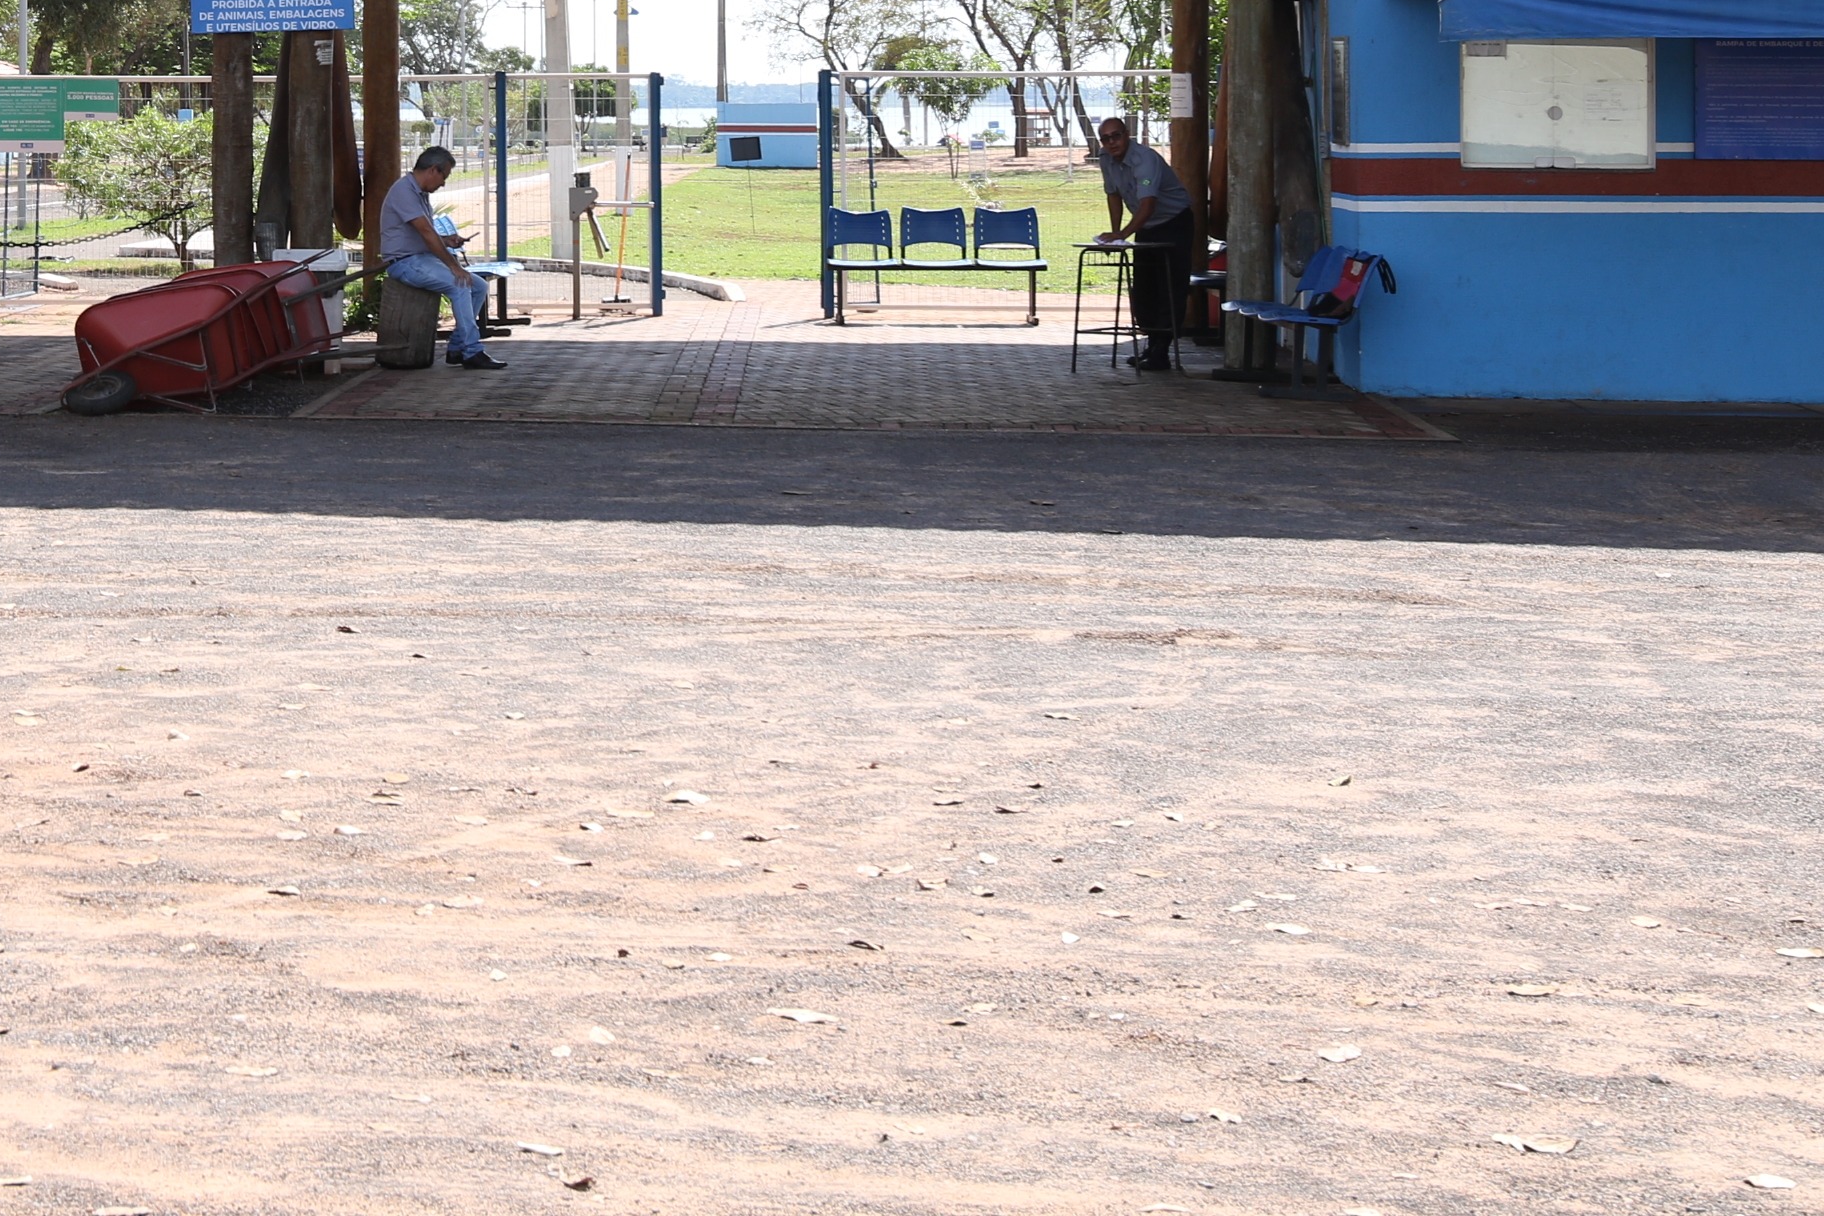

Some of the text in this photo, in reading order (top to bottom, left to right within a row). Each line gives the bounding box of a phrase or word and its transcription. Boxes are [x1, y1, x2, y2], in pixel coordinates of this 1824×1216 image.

[212, 0, 265, 9] PROIBIDA
[199, 9, 345, 21] DE ANIMAIS, EMBALAGENS
[206, 20, 338, 32] E UTENSÍLIOS DE VIDRO.
[1759, 40, 1805, 48] EMBARQUE
